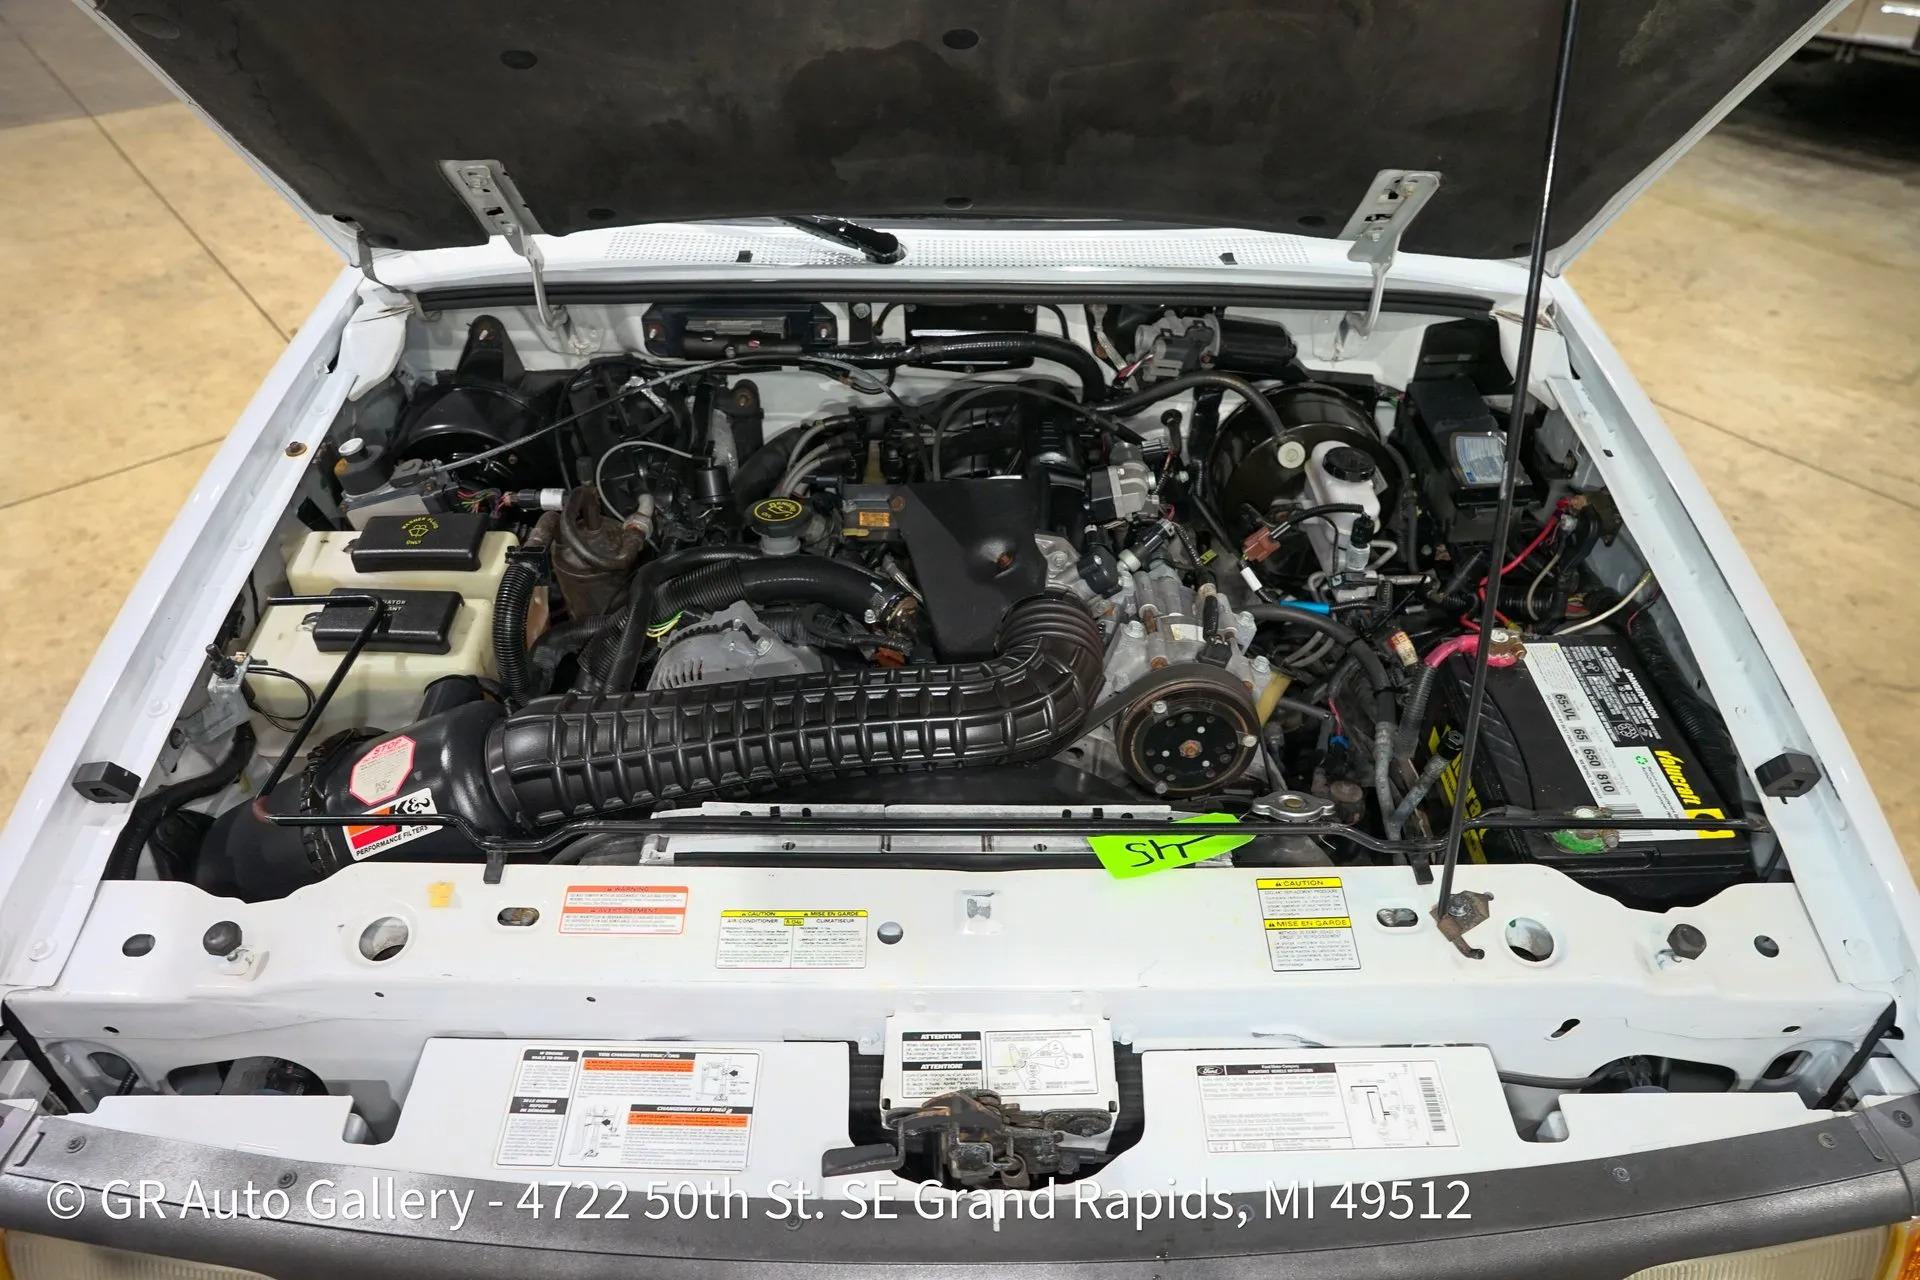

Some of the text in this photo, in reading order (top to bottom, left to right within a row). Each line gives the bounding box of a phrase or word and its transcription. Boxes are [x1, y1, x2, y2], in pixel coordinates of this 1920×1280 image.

[1573, 728, 1589, 741] 65
[374, 738, 403, 756] STOP
[1583, 748, 1602, 768] 650
[1597, 773, 1616, 793] 810
[1653, 750, 1702, 805] Valucraft
[355, 825, 429, 857] PERFORMANCE FILTERS
